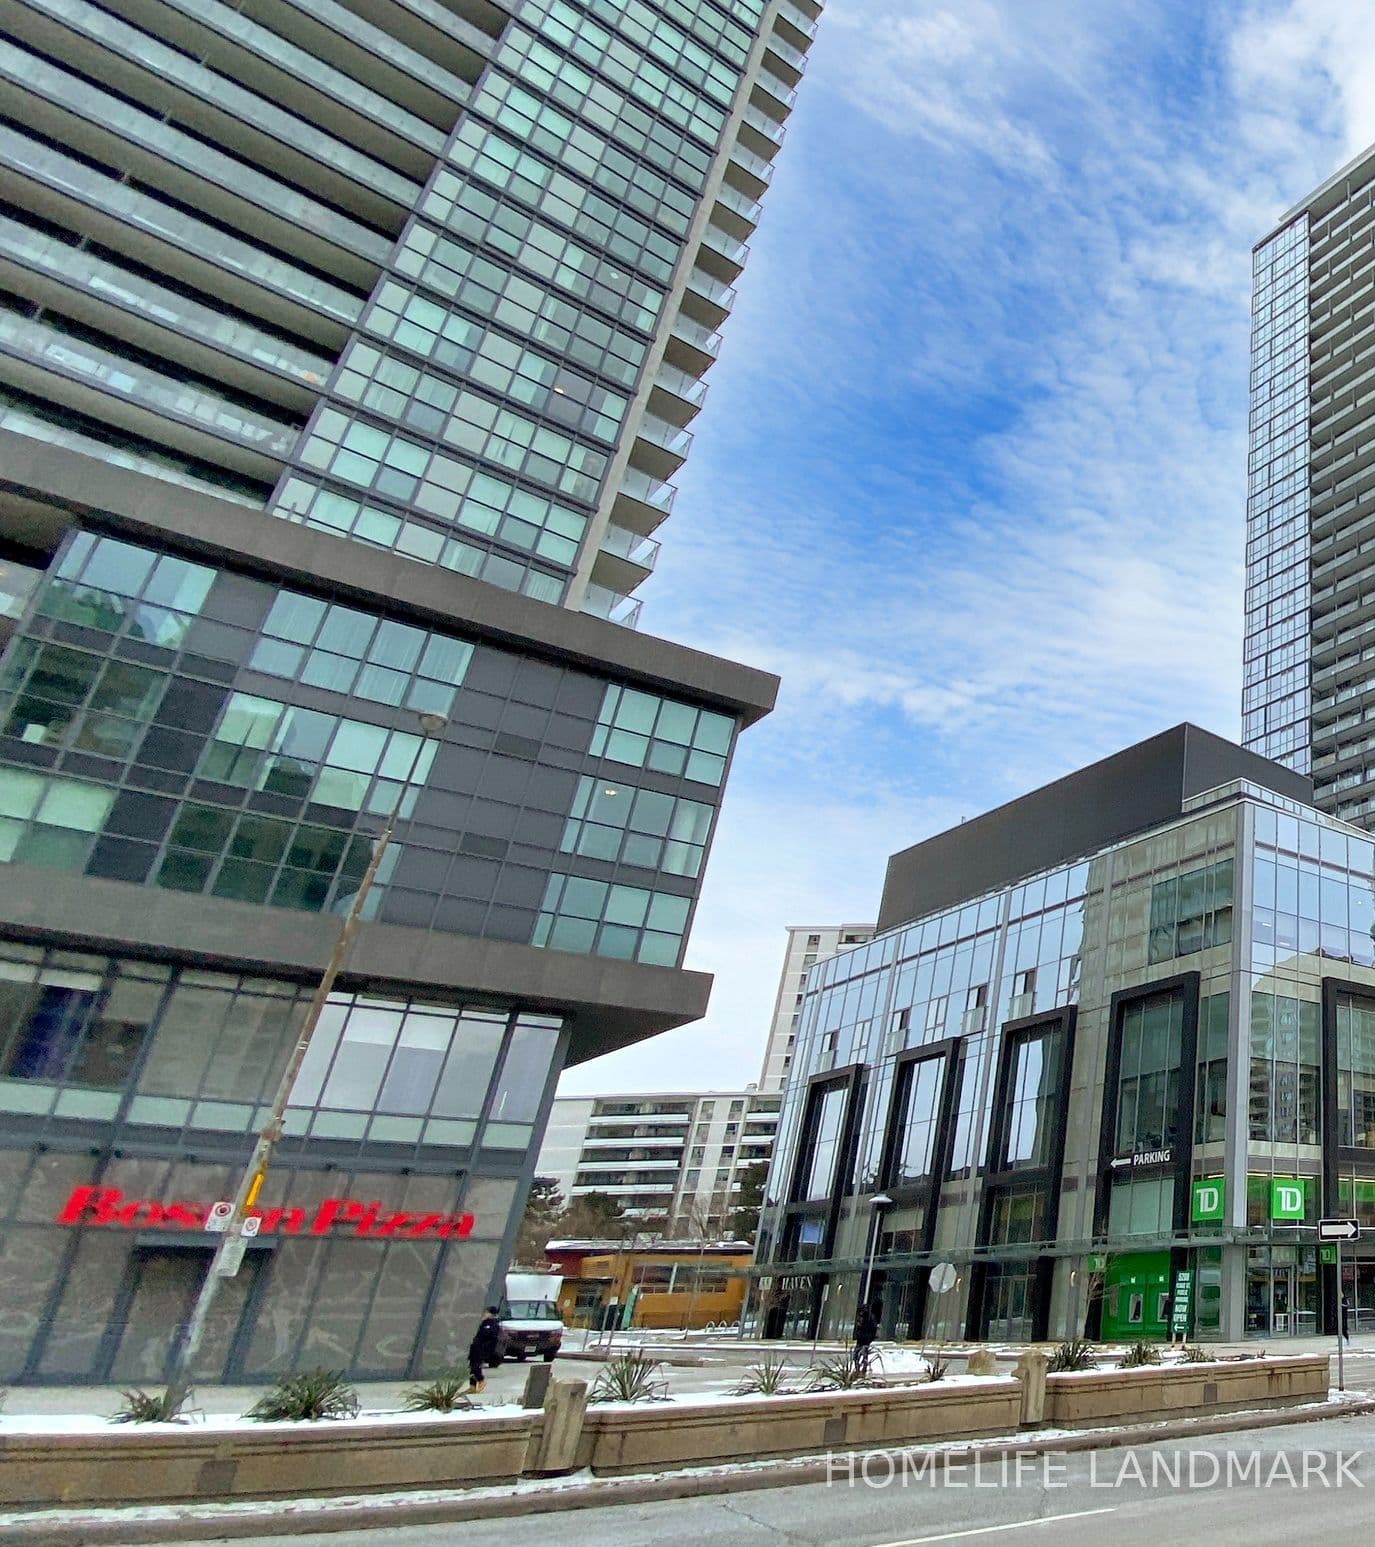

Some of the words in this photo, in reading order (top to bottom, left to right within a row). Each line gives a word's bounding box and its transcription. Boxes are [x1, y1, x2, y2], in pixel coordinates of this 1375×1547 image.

[1133, 1150, 1170, 1166] PARKING
[1196, 1187, 1218, 1212] TD
[1277, 1187, 1301, 1211] TD
[310, 1199, 476, 1238] Pizza
